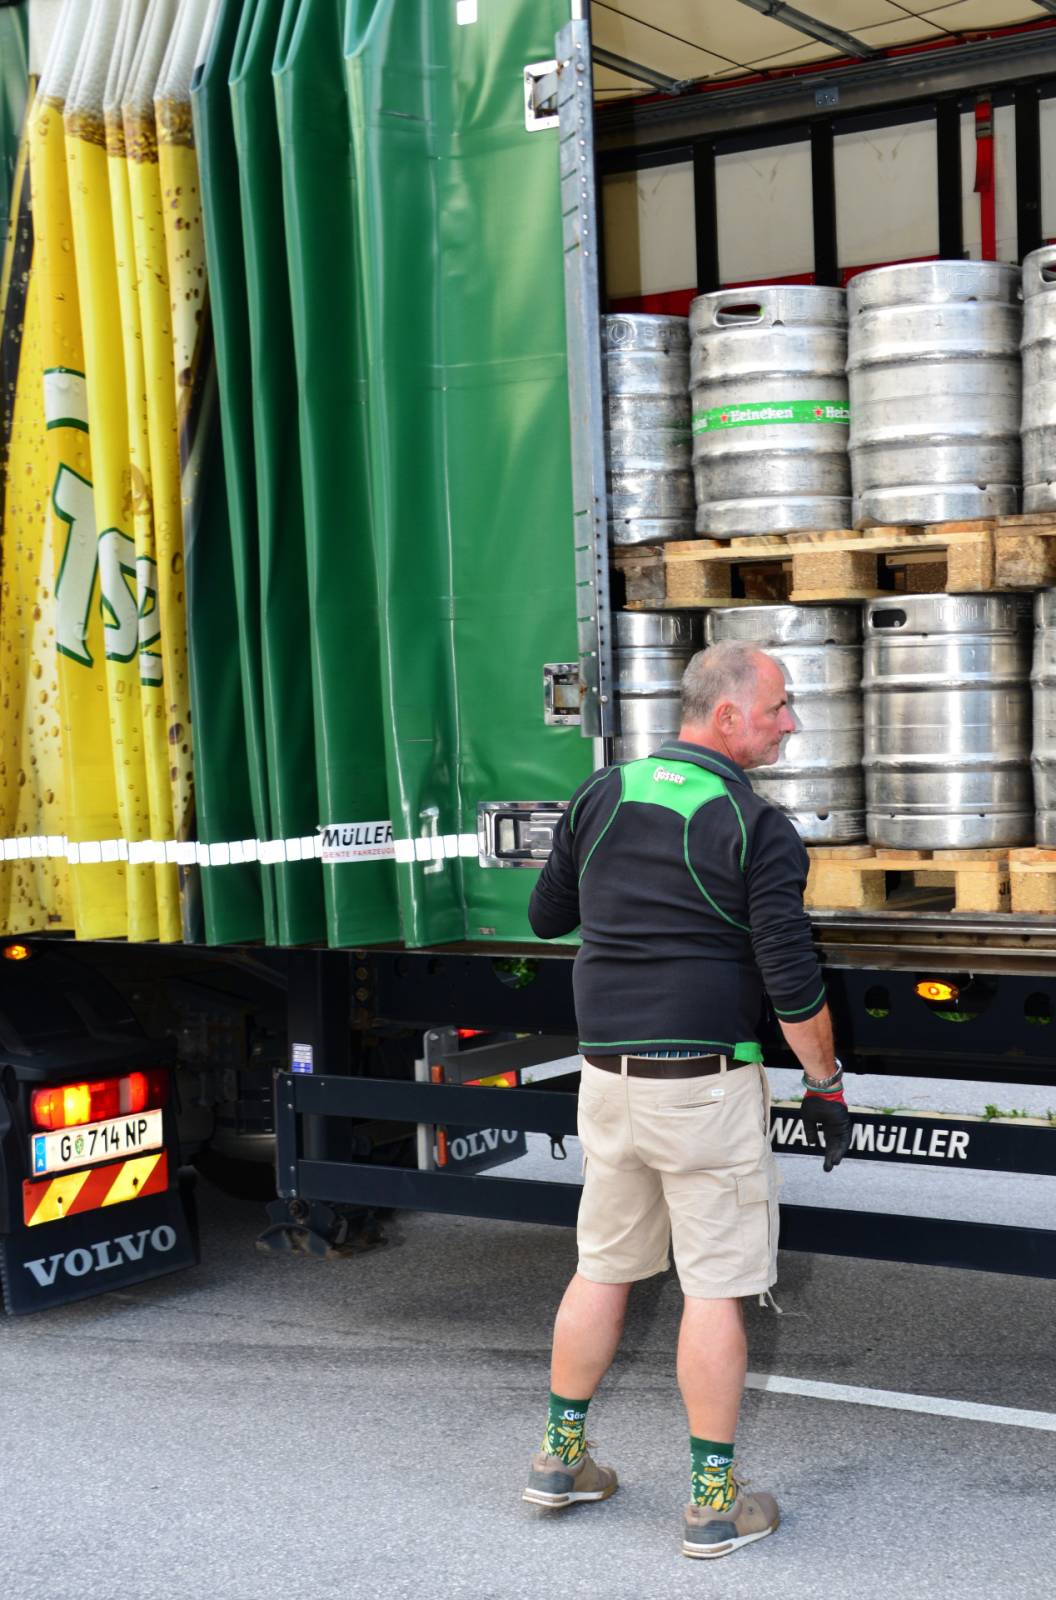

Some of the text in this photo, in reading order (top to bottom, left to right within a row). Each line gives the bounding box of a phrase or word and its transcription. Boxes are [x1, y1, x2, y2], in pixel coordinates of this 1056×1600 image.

[730, 408, 794, 423] Heineken
[322, 825, 394, 847] MÜLLER
[61, 1119, 147, 1162] G 714 NP
[433, 1127, 519, 1167] OLVO
[769, 1117, 970, 1160] WAMÜLLER
[23, 1225, 177, 1287] VOLVO
